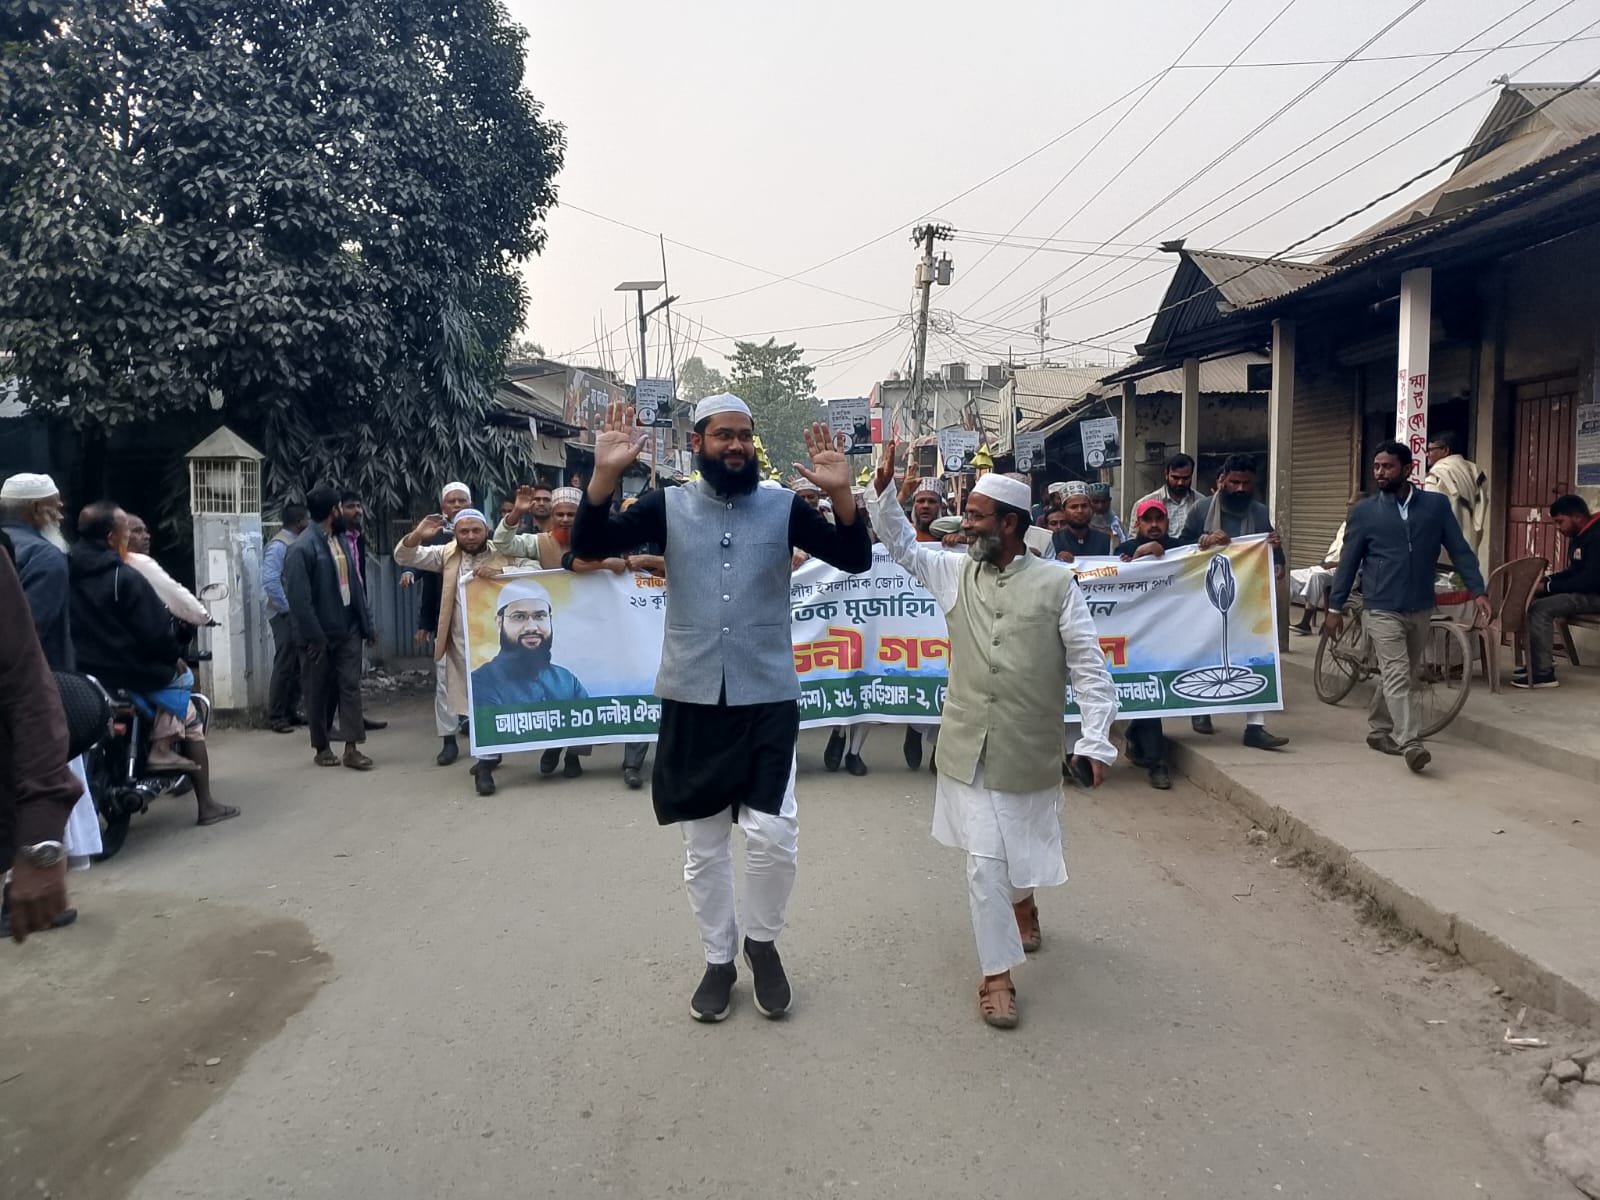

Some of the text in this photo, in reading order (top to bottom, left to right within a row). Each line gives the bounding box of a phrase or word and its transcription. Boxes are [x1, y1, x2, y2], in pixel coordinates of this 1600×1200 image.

[630, 596, 647, 608] ২৬
[816, 575, 871, 595] ইসলামিক
[875, 575, 903, 590] জোট
[843, 592, 936, 624] মুজাহিদ
[495, 709, 566, 735] আয়োজনে:
[571, 708, 593, 728] ১০
[597, 699, 631, 725] দলীয়
